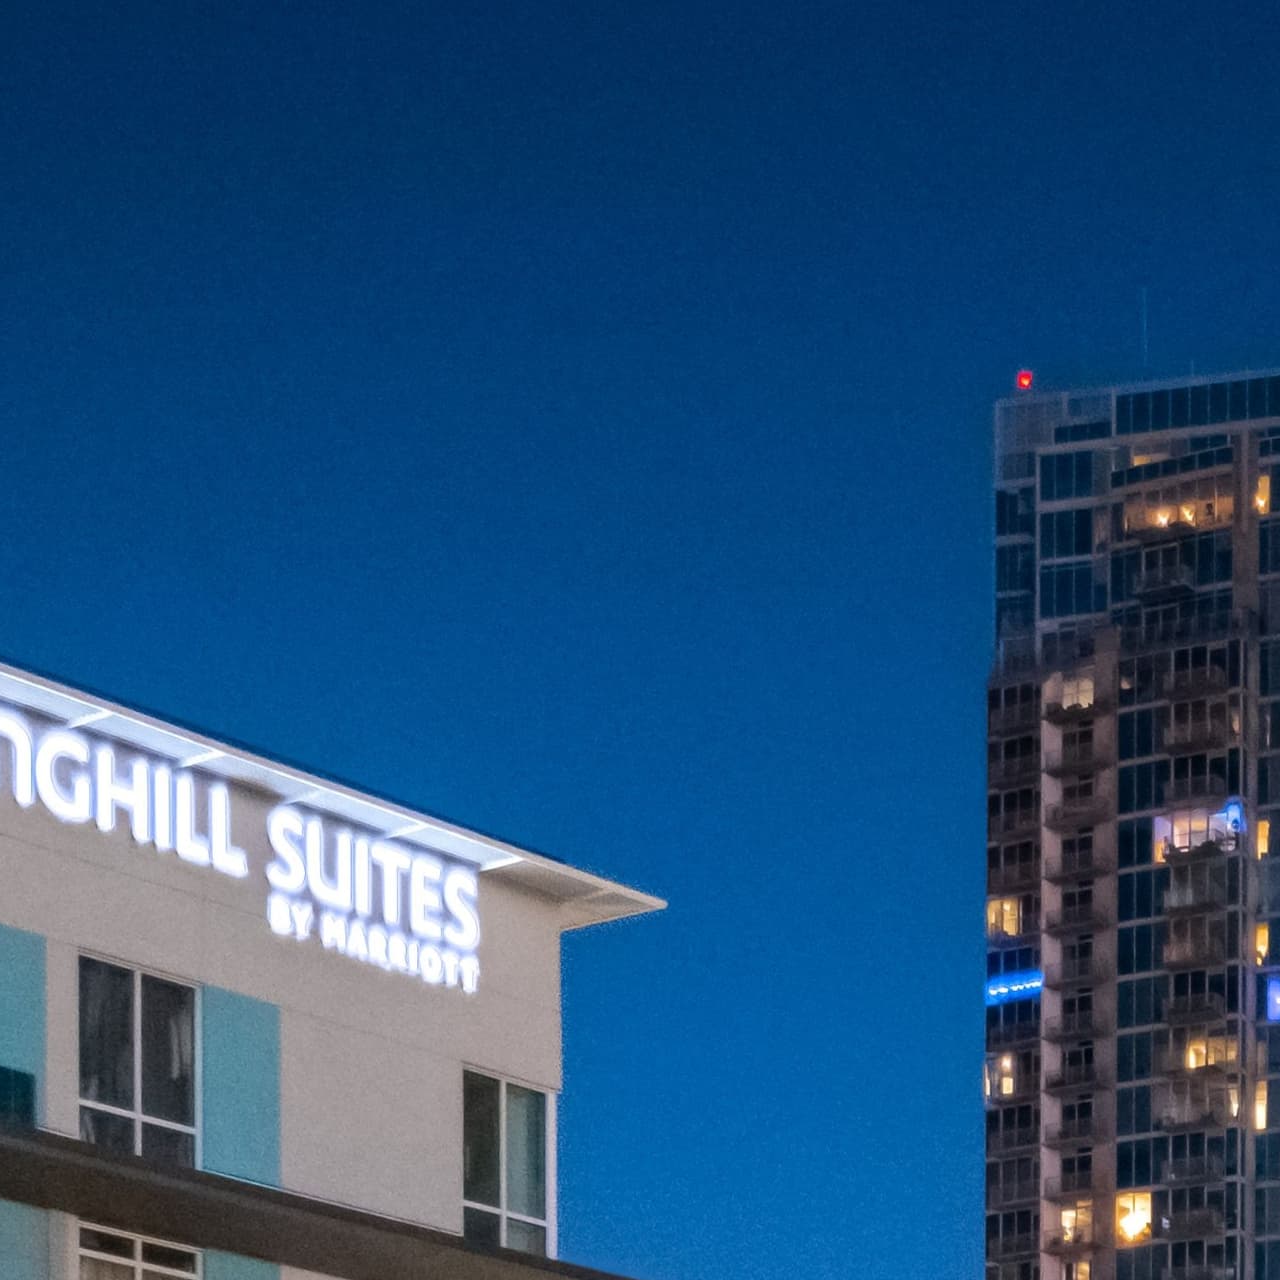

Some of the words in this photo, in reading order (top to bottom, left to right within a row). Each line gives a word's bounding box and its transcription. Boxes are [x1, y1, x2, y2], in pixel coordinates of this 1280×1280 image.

[267, 806, 480, 951] SUITES
[268, 893, 314, 941] BY
[321, 911, 480, 994] MARRIOTT
